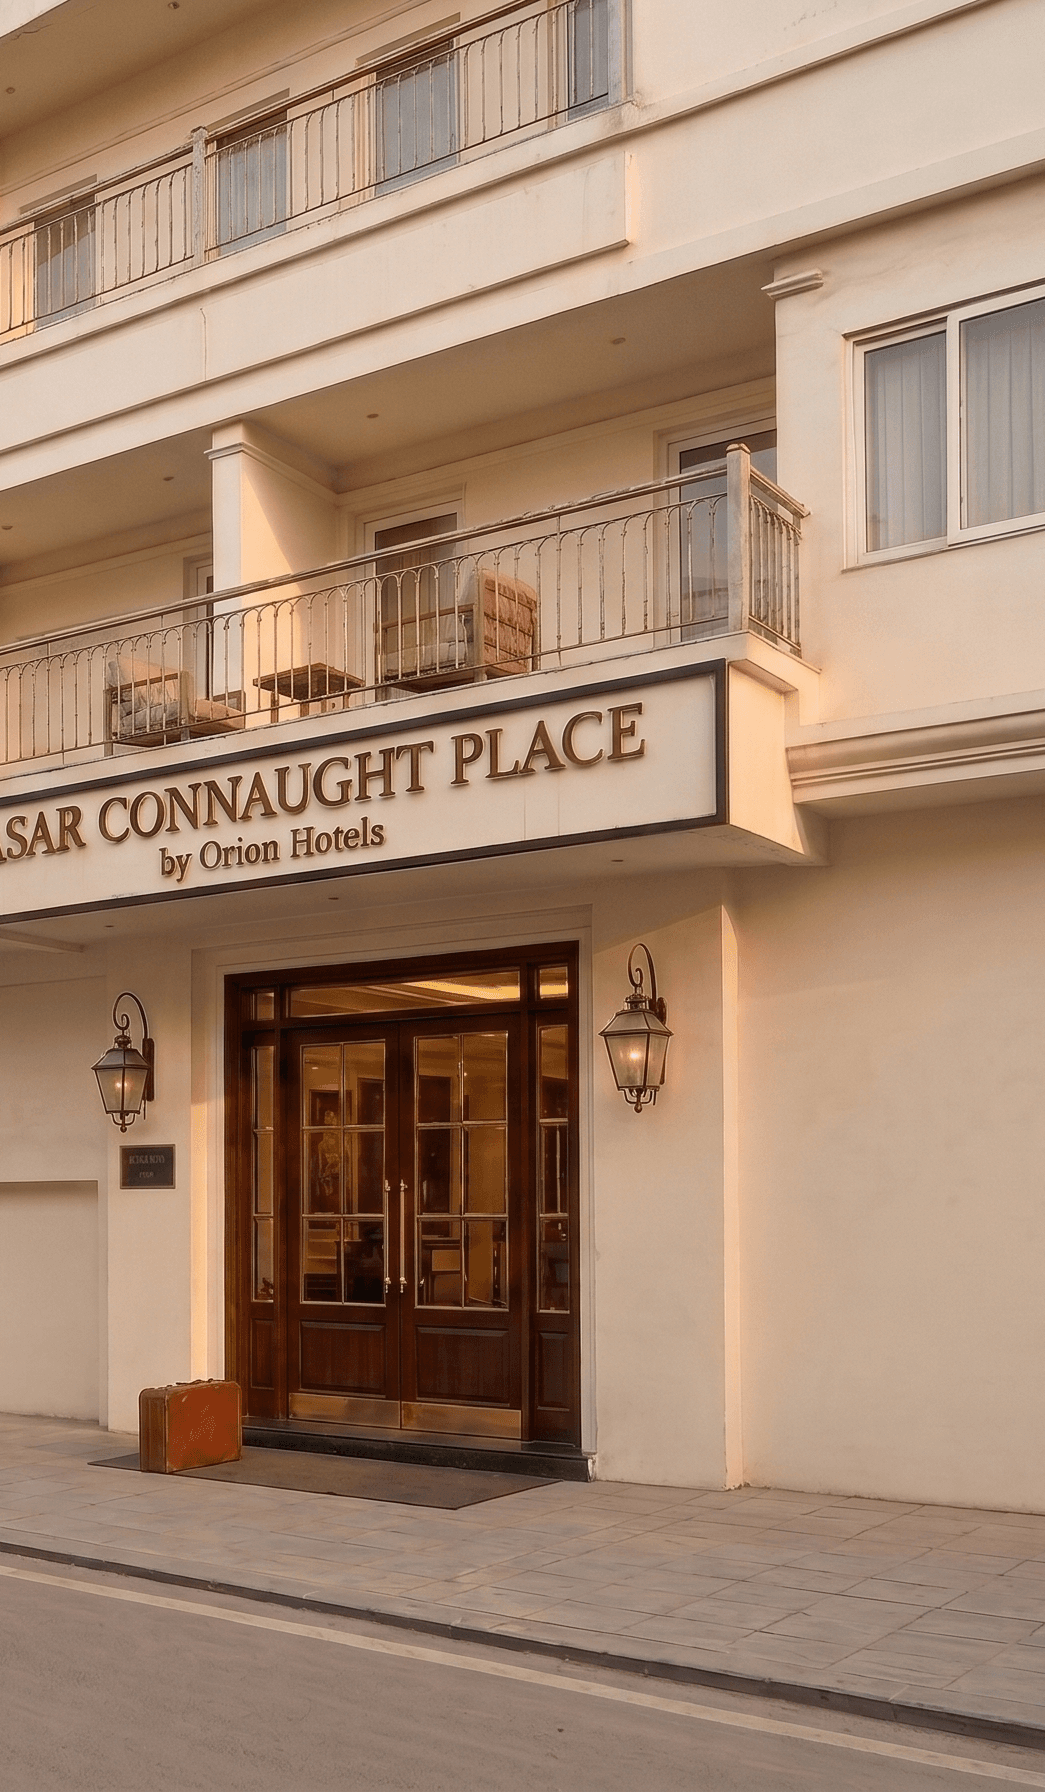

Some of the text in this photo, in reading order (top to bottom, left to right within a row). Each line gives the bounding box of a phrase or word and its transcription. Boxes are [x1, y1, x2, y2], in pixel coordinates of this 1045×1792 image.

[98, 740, 434, 843] CONNAUGHT
[450, 702, 645, 786] PLACE
[159, 816, 386, 883] by Orion Hotels
